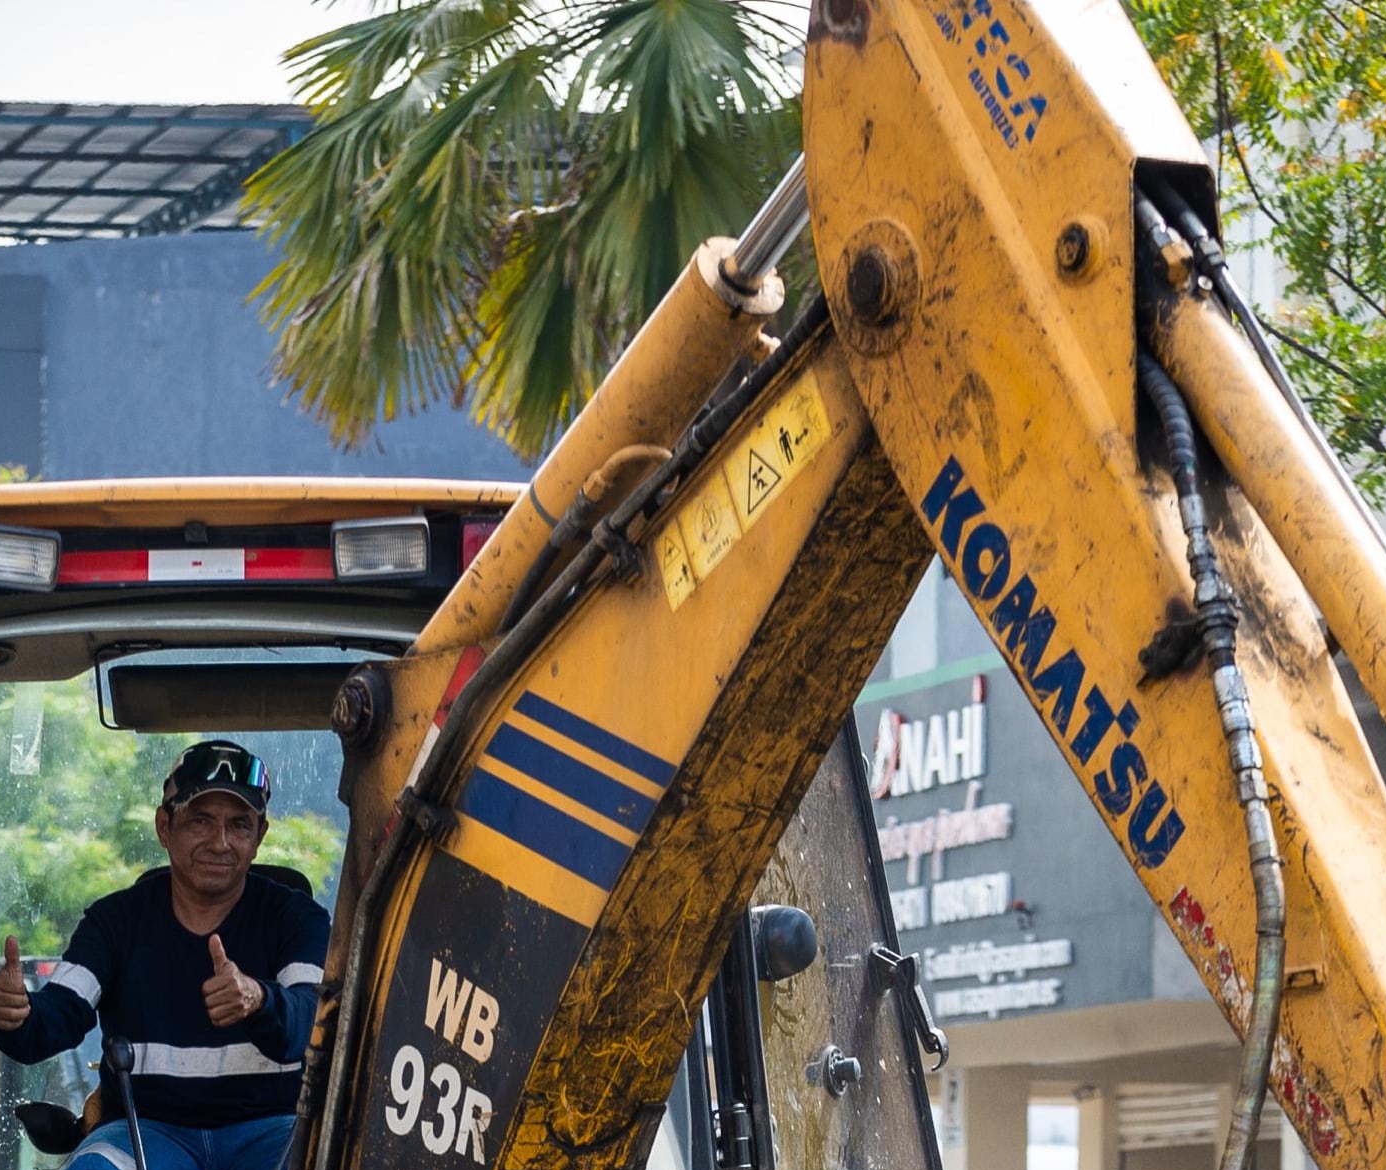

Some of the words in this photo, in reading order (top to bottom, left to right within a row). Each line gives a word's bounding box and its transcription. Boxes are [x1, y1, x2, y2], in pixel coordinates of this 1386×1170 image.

[921, 453, 1186, 870] KOMATSU
[424, 957, 500, 1064] WB
[385, 1045, 493, 1165] 93R
